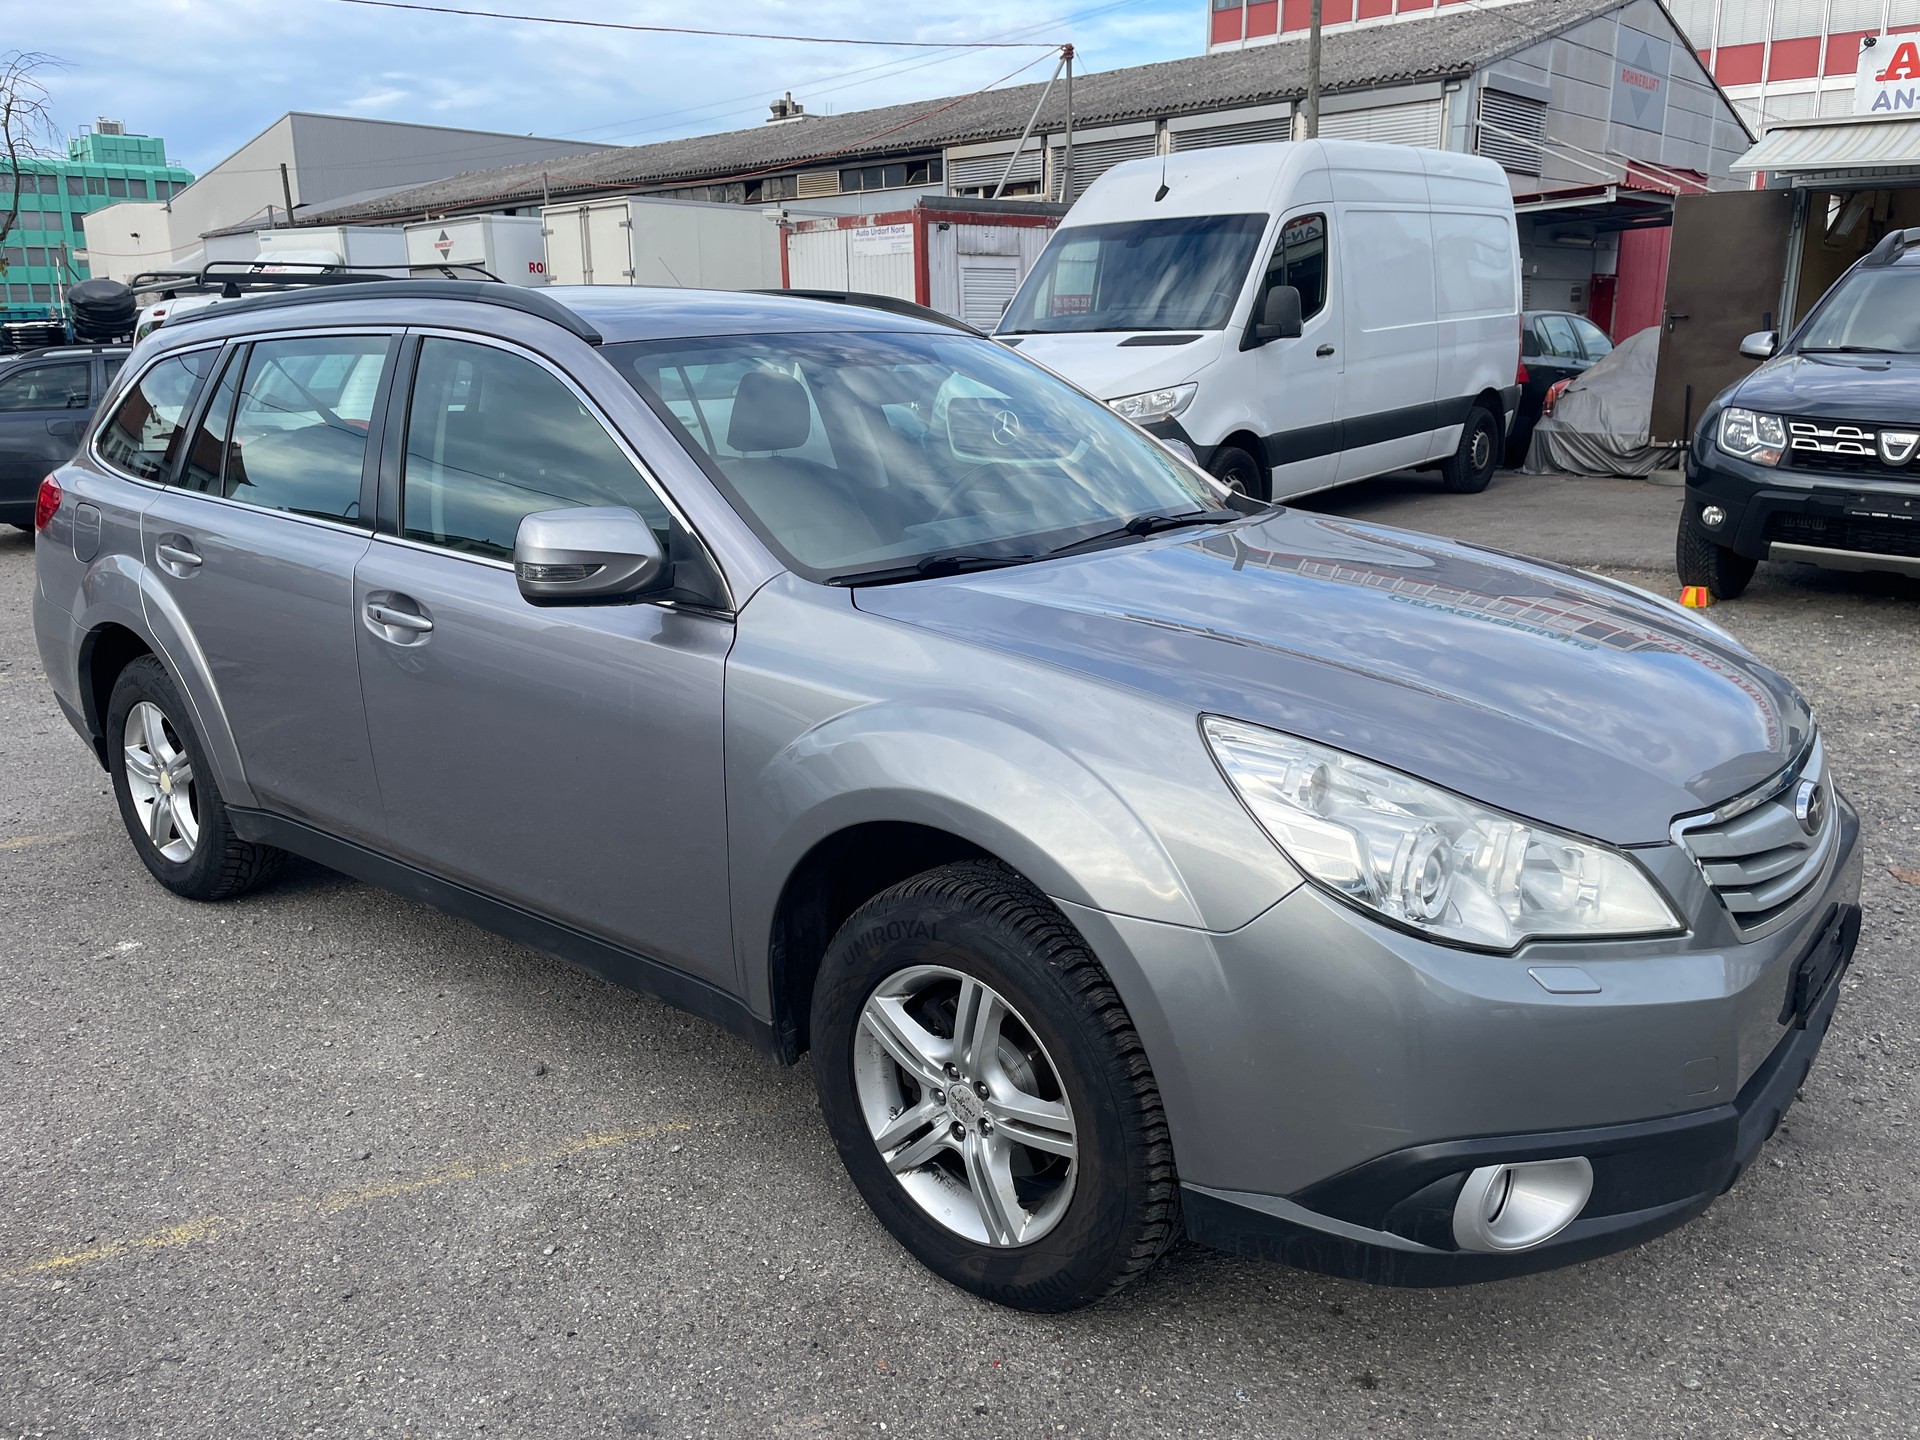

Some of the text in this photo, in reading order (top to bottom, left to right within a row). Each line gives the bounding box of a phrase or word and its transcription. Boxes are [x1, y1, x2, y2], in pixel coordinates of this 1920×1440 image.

[1622, 68, 1660, 93] ROHNERLUFT
[856, 225, 905, 237] Auto Urdorf Nord
[841, 919, 945, 967] UNIROYAL
